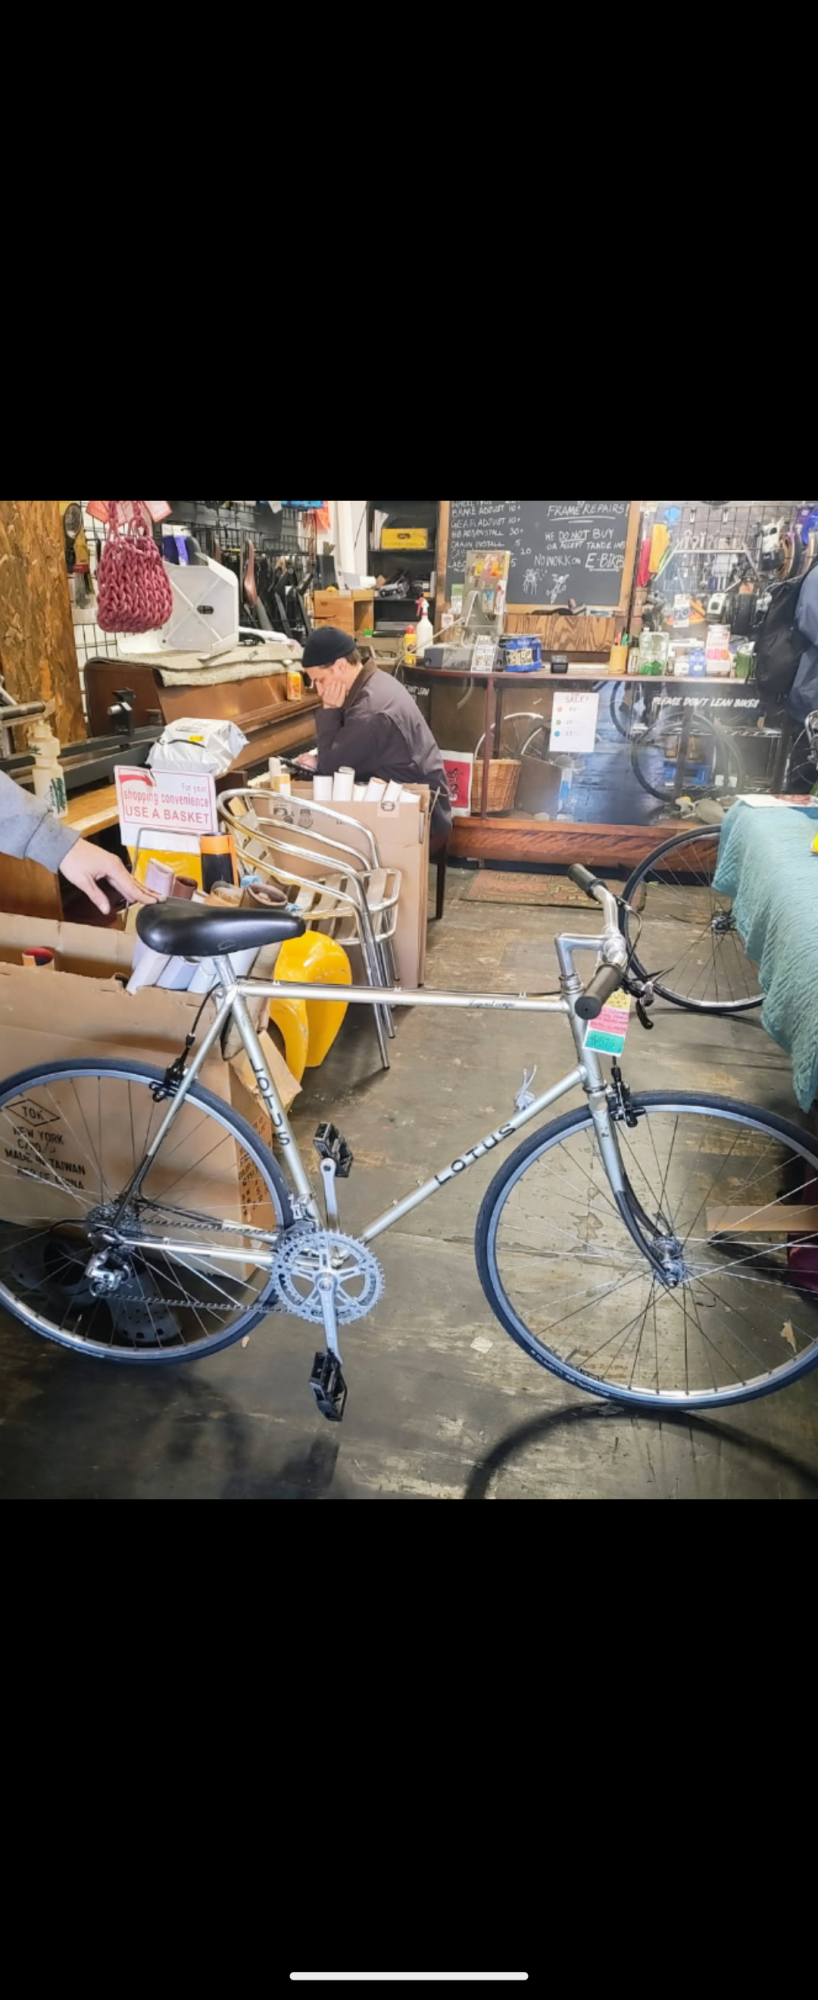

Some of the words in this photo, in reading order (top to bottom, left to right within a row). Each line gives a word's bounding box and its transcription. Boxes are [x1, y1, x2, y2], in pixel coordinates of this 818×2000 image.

[479, 504, 505, 515] ADJUST
[547, 505, 580, 517] FRAME
[478, 517, 506, 527] ADJUST
[545, 532, 555, 541] WE
[592, 528, 614, 540] BUY
[652, 696, 682, 706] PLEASE
[683, 697, 709, 706] DON'T
[710, 698, 733, 707] LEAN
[733, 699, 760, 708] BIKES
[181, 782, 191, 792] For
[193, 785, 207, 793] your
[124, 789, 158, 805] shopping
[161, 793, 209, 807] convenience
[125, 806, 149, 818] USE
[152, 809, 161, 819] A
[164, 810, 209, 824] BASKET
[250, 1058, 291, 1146] LOTUS
[22, 1106, 45, 1120] TOK
[13, 1126, 34, 1138] NEW
[38, 1130, 64, 1145] YORK
[434, 1123, 516, 1185] LOTUS
[4, 1148, 33, 1163] MADE
[49, 1158, 86, 1176] TAIWAN
